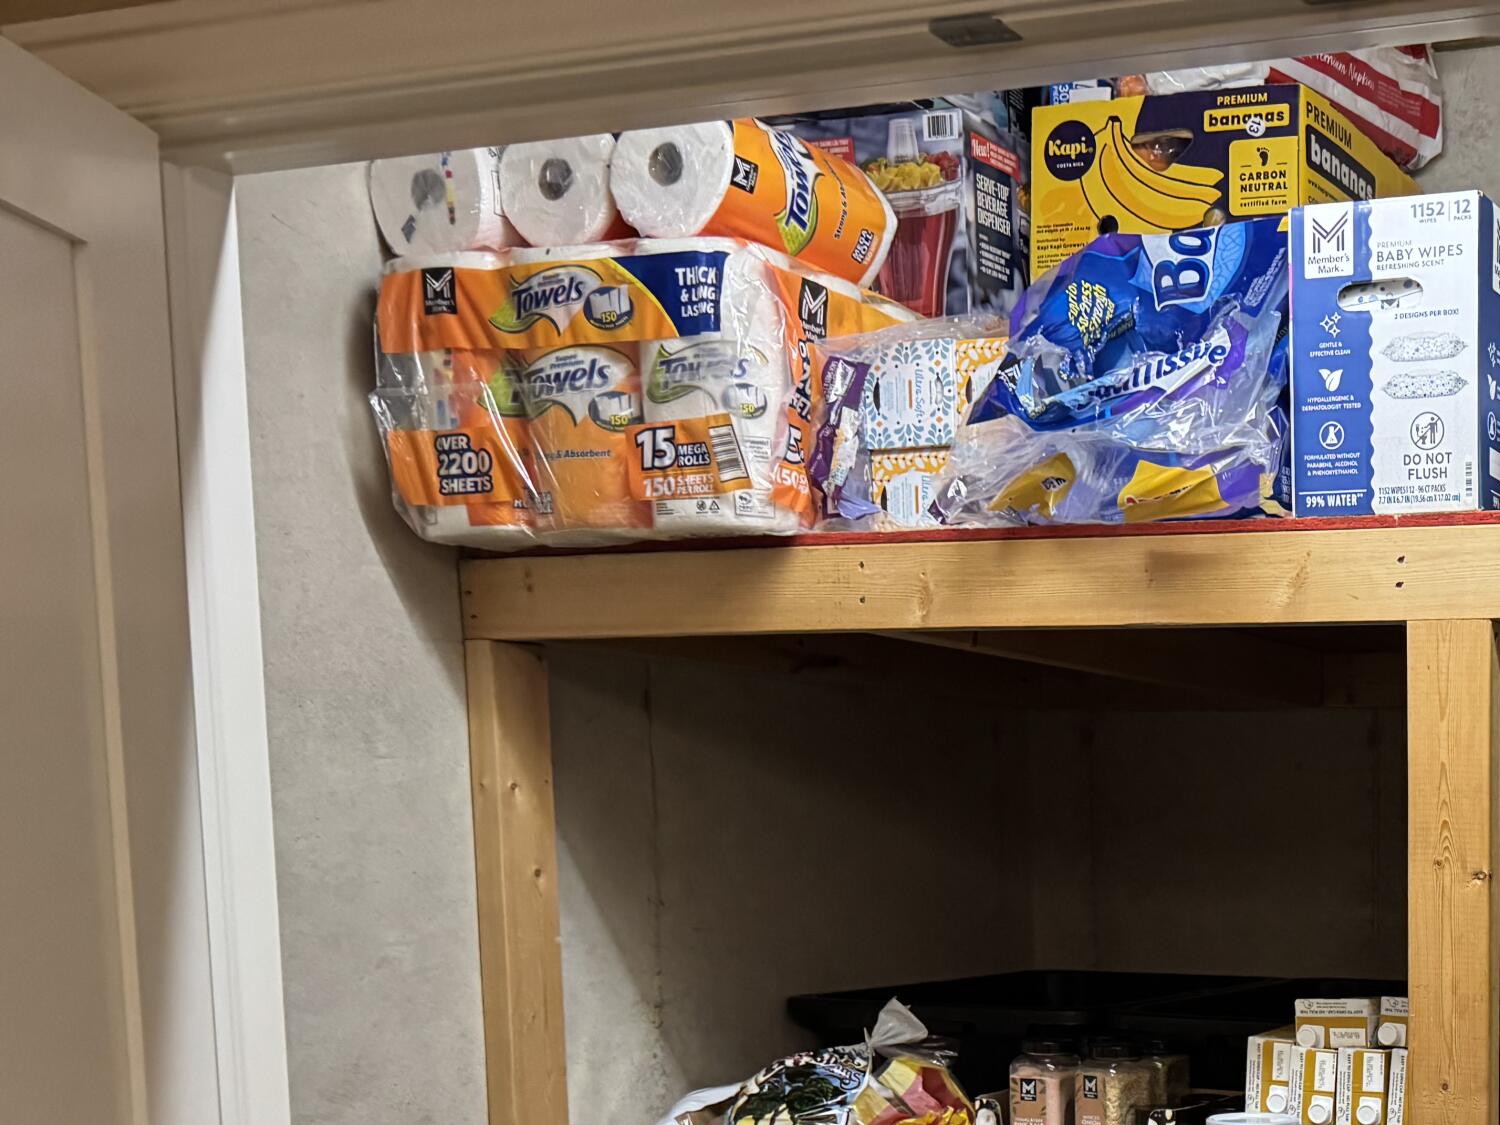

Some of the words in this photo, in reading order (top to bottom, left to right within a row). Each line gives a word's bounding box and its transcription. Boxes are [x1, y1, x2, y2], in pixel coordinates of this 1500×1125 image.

[1216, 92, 1268, 107] PREMIUM
[1306, 101, 1353, 151] PREMIUM
[1309, 133, 1375, 200] bananas
[1238, 170, 1287, 182] CARBON
[1239, 181, 1288, 193] NEUTRAL
[976, 189, 1009, 219] BEVERAGE
[1410, 200, 1445, 218] 1152
[1453, 199, 1471, 214] 12
[977, 207, 1011, 238] DISPENSER
[1377, 239, 1412, 249] PREMIUM
[1307, 252, 1350, 265] Member's
[1376, 248, 1414, 263] BABY
[1418, 243, 1463, 258] WIPES
[1317, 264, 1340, 275] Mark
[1376, 261, 1420, 271] REFRESHING
[1421, 258, 1445, 267] SCENT
[675, 266, 717, 286] THICK
[511, 277, 585, 321] Towels
[600, 311, 617, 323] 150
[1399, 311, 1429, 320] DESIGNS
[1430, 310, 1442, 318] PER
[1442, 308, 1460, 317] BOX!
[1309, 350, 1335, 358] EFFECTIVE
[1343, 402, 1362, 410] TESTED
[563, 448, 611, 460] Absorbent
[635, 427, 677, 471] 15
[677, 443, 707, 456] MEGA
[678, 454, 711, 467] ROLLS
[1304, 453, 1336, 461] FORMULATED
[1336, 452, 1361, 460] WITHOUT
[1403, 453, 1423, 466] DO
[1425, 451, 1453, 465] NOT
[439, 451, 491, 476] 2200
[1334, 460, 1358, 468] ALCOHOL
[1407, 466, 1448, 480] FLUSH
[440, 477, 492, 494] SHEETS
[642, 477, 676, 498] 150
[1306, 496, 1325, 508] 99%
